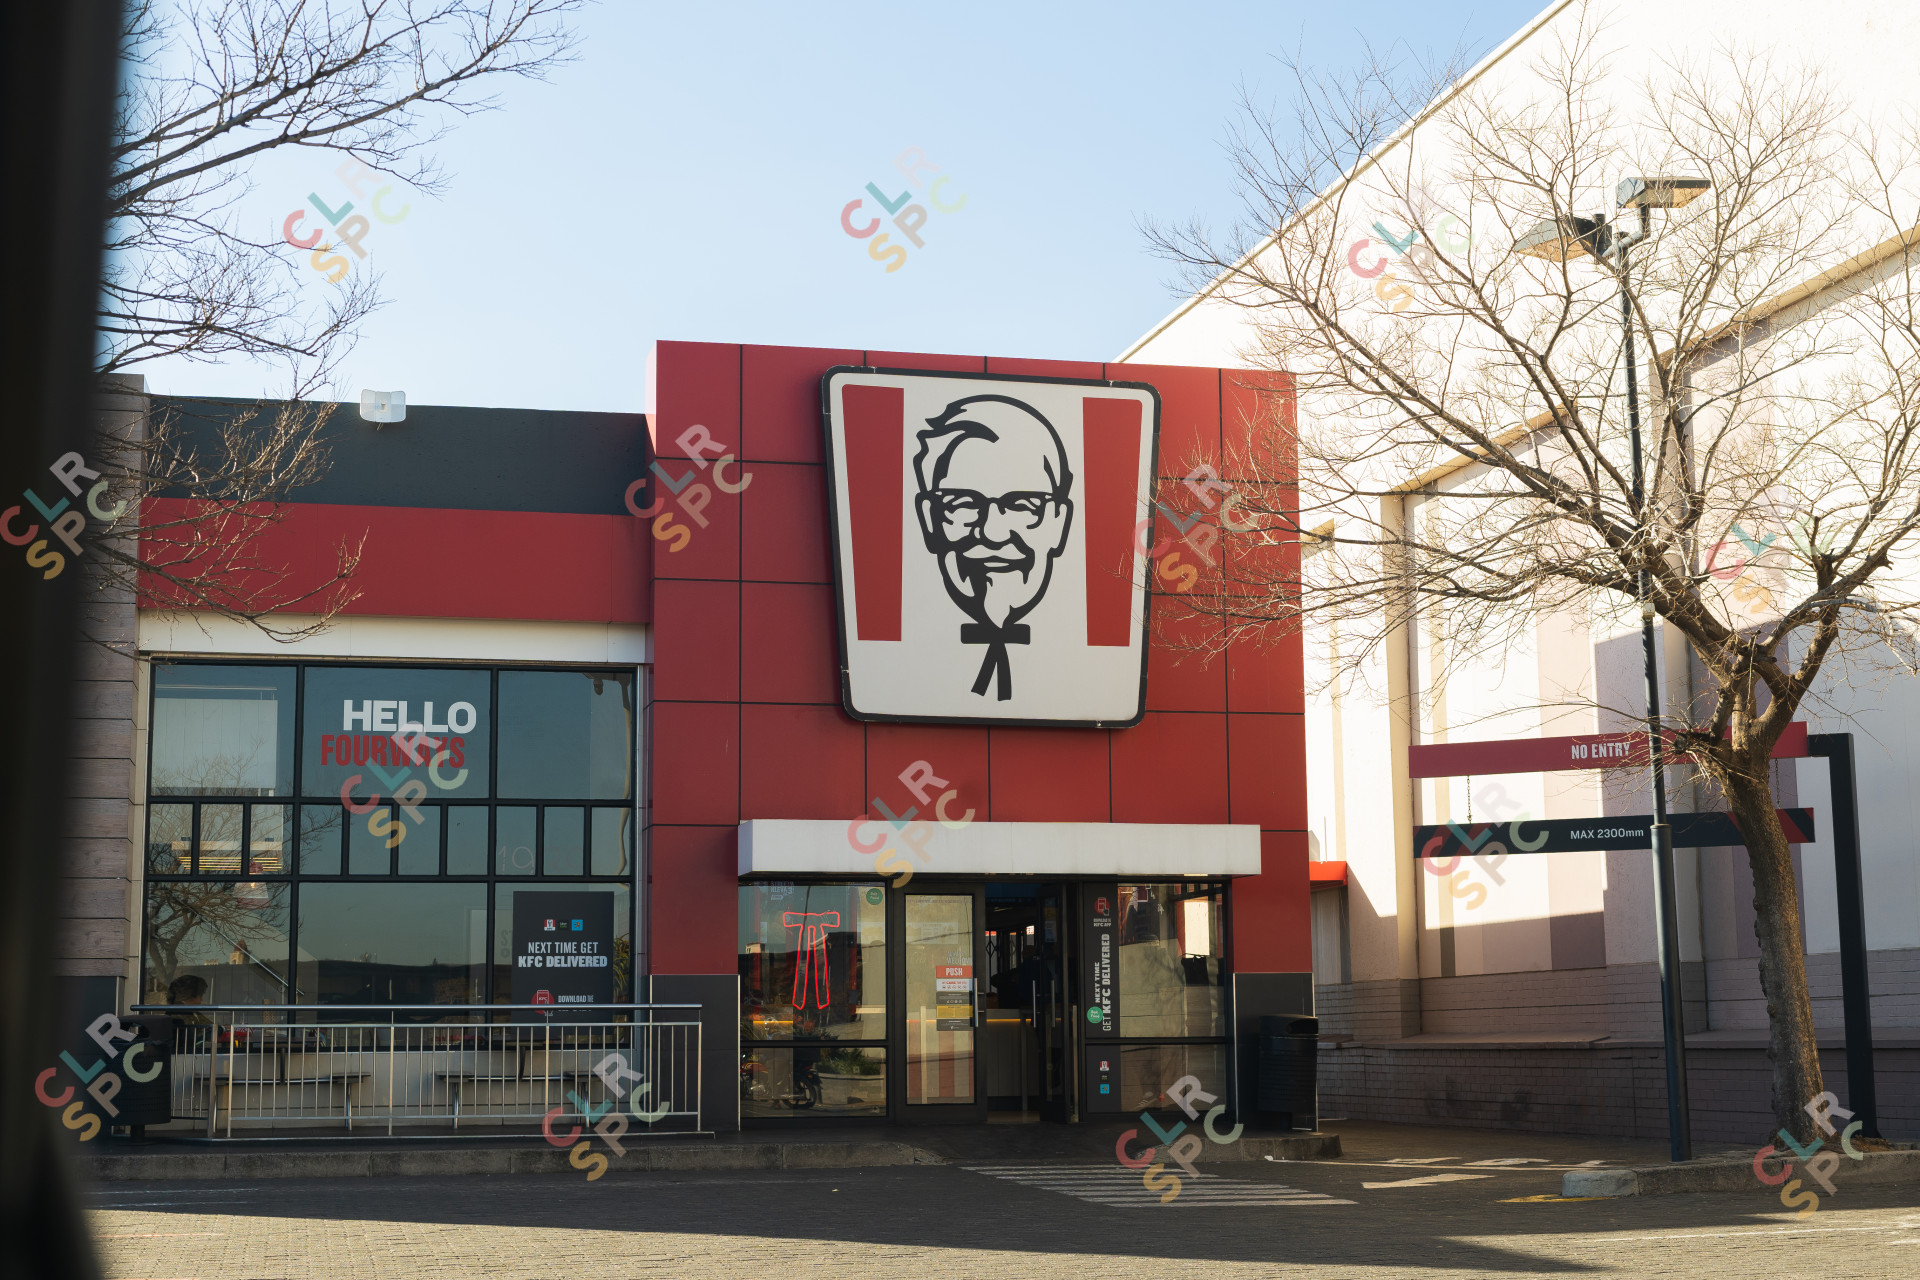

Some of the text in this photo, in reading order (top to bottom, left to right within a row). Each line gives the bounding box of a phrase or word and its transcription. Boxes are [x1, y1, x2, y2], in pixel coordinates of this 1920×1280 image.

[343, 700, 477, 734] HELLO
[321, 734, 465, 768] FOURWAYS
[1571, 742, 1630, 760] NO ENTRY
[1570, 828, 1644, 840] MAX 2300mm
[528, 942, 598, 953] NEXT TIME GET
[518, 956, 608, 968] KFC DELIVERED
[1102, 934, 1111, 1031] GET KFC DELIVERED
